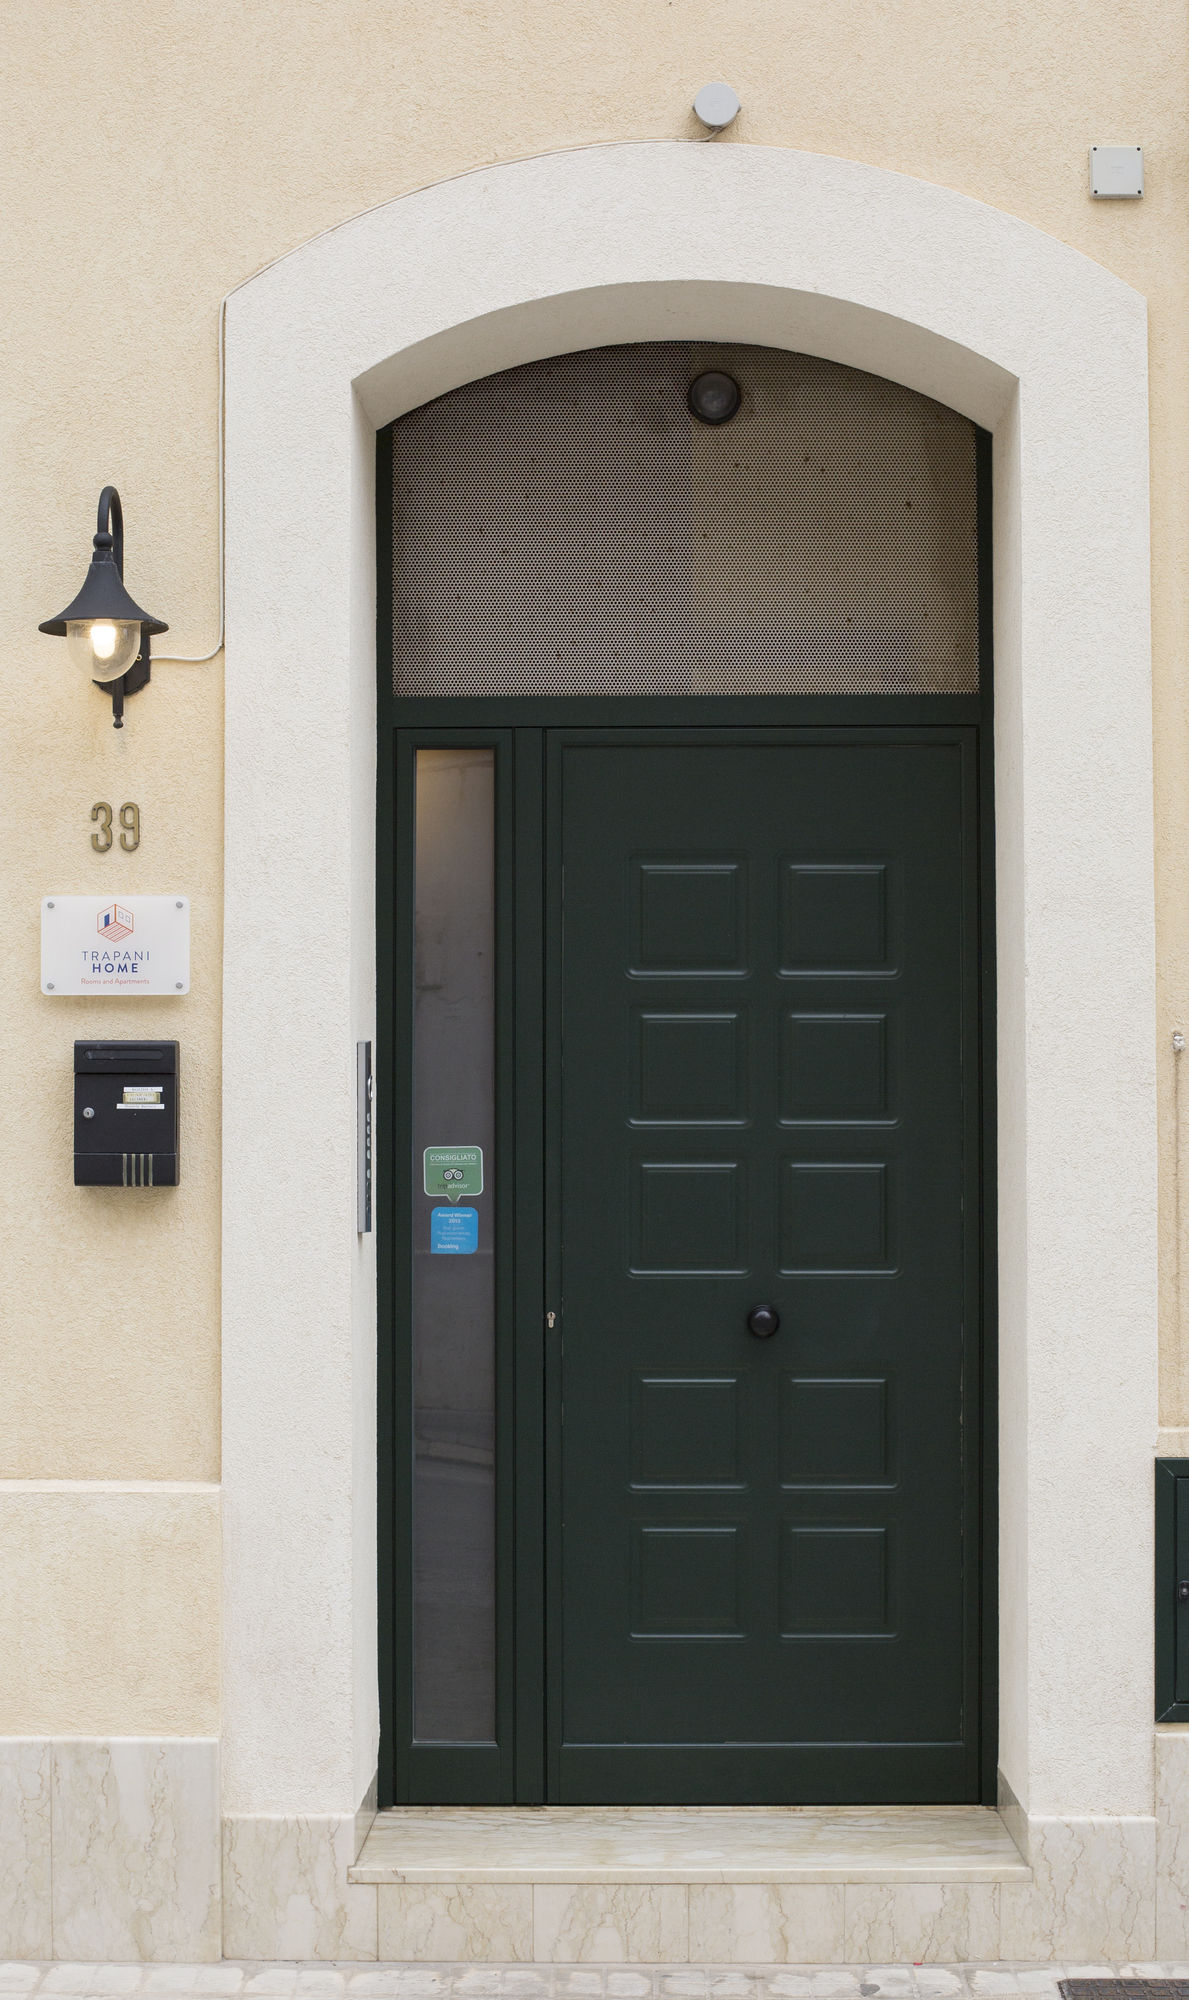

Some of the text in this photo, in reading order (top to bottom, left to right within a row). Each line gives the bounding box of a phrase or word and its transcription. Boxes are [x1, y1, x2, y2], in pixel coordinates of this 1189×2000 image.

[91, 801, 140, 852] 39
[81, 951, 150, 961] TRAPANI
[92, 962, 138, 973] HOME
[115, 978, 150, 987] Apartments
